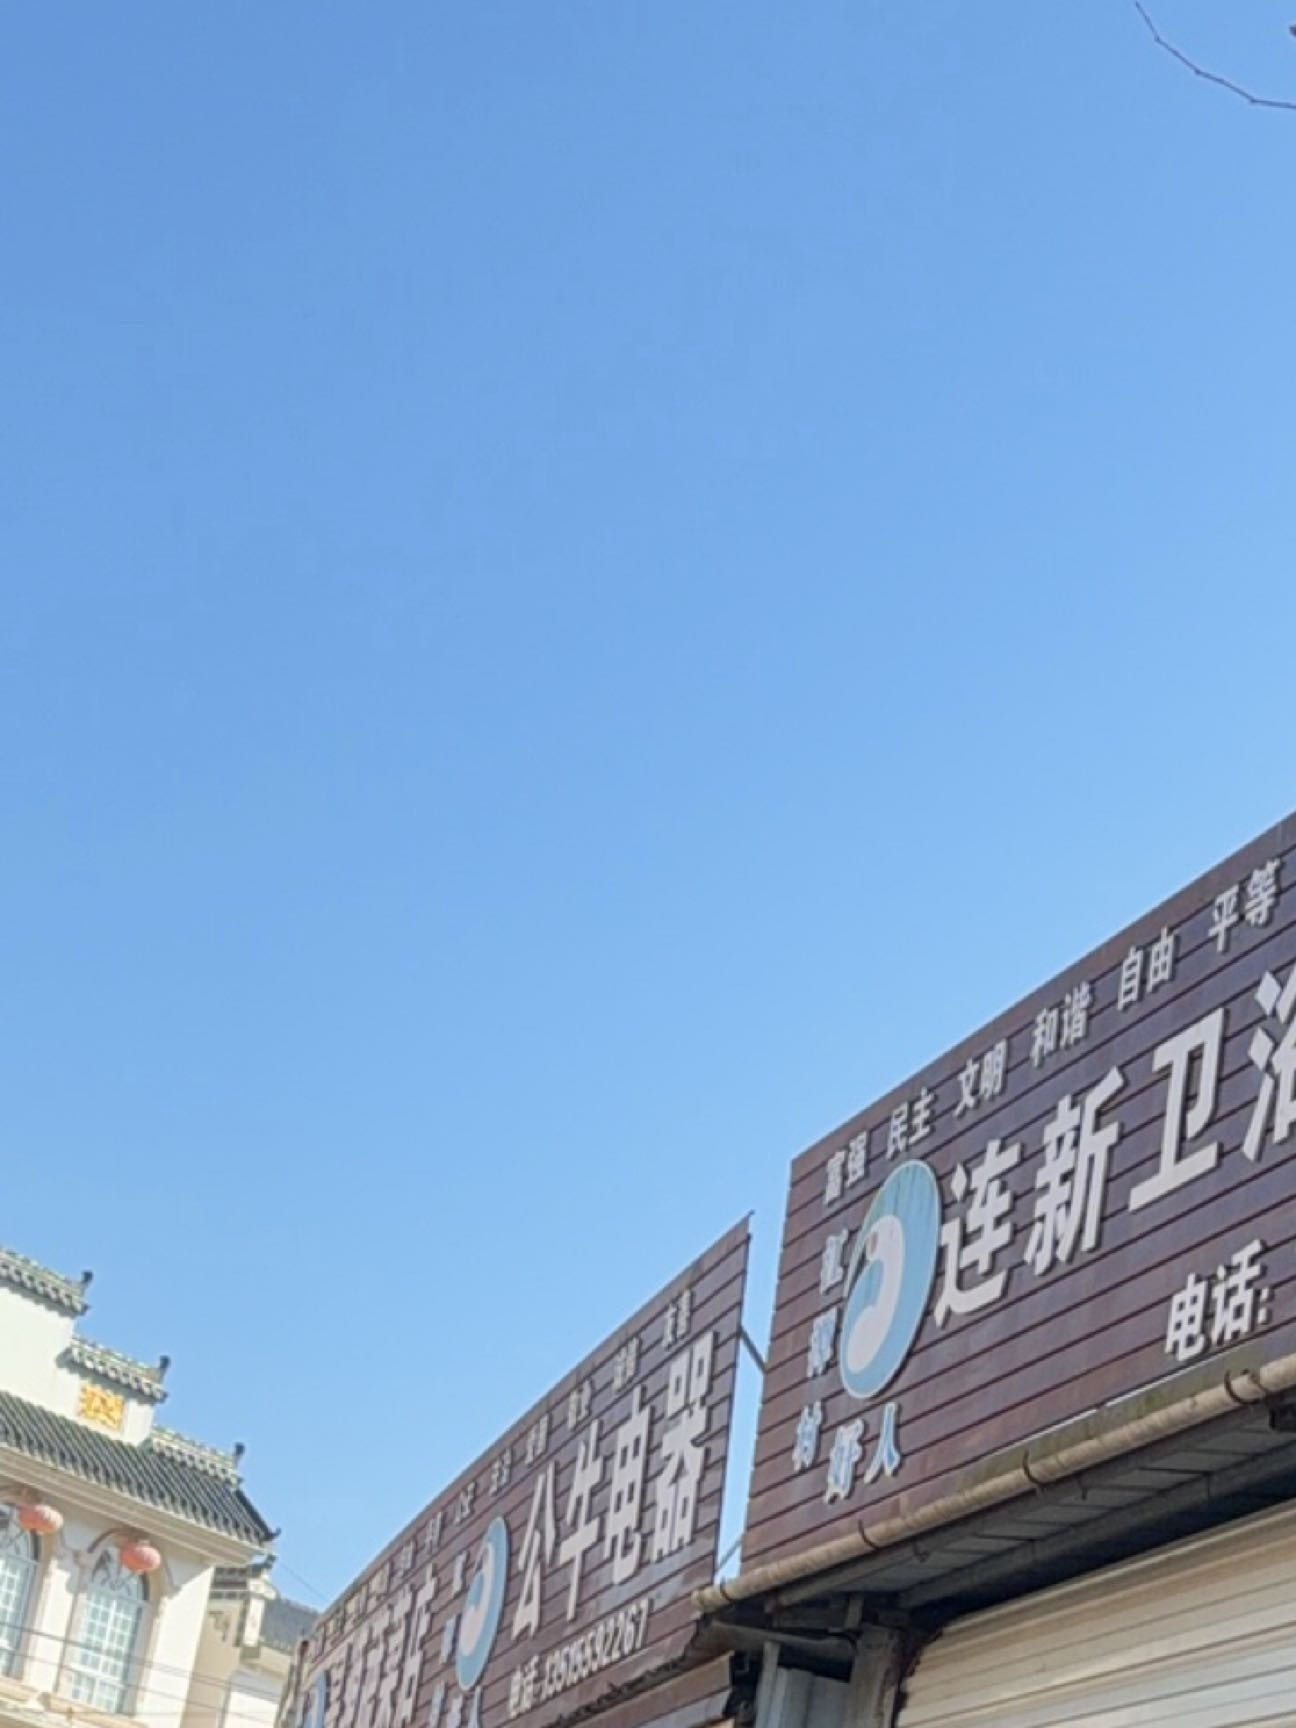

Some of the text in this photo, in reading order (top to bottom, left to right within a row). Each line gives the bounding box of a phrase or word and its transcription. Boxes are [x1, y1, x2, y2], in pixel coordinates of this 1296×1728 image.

[1030, 982, 1093, 1066] 和谐
[1118, 927, 1174, 1009] 自由
[1209, 860, 1280, 951] 平等
[513, 1331, 713, 1638] 公牛电器
